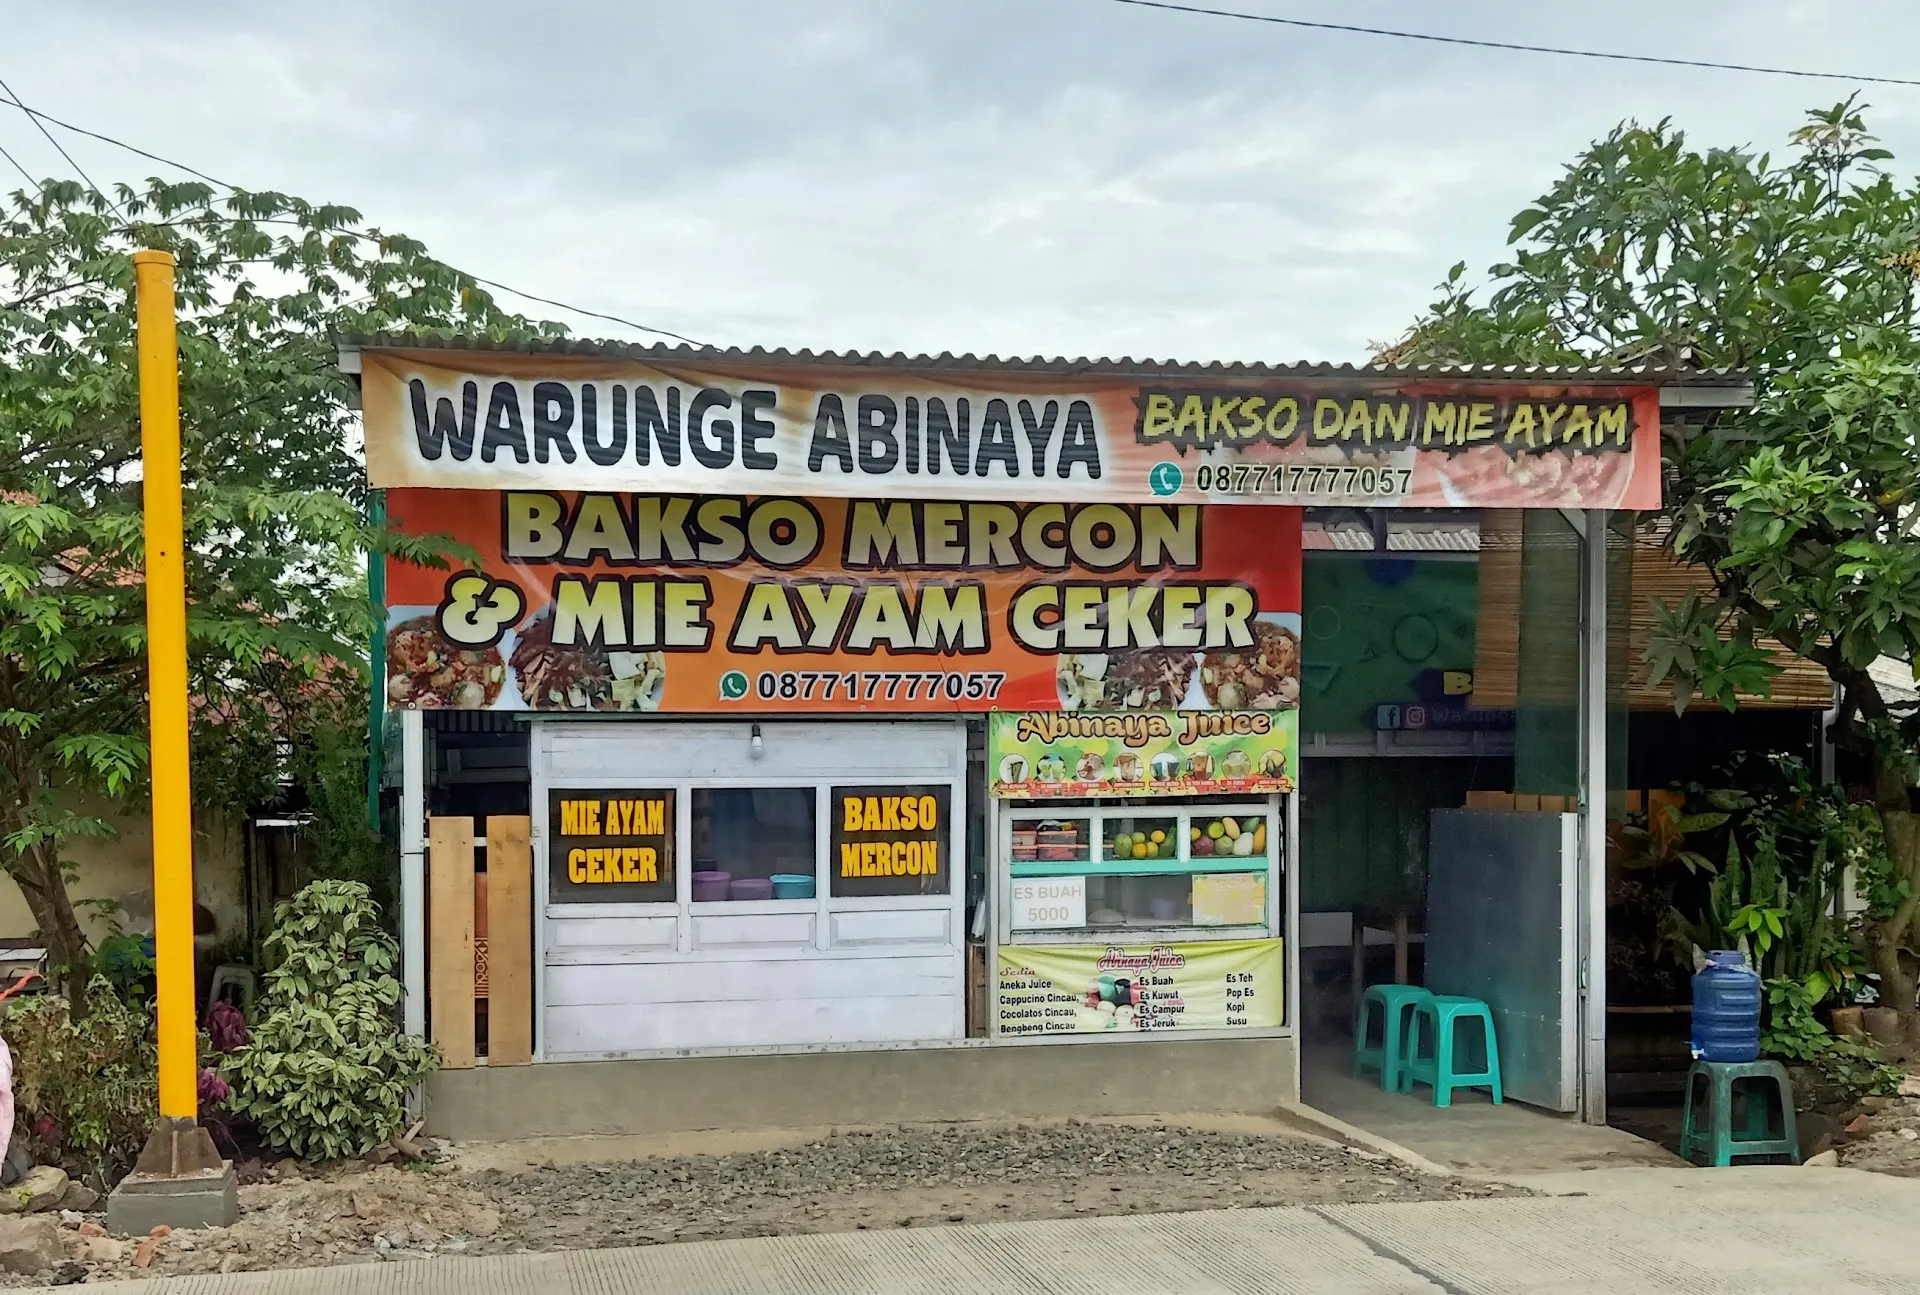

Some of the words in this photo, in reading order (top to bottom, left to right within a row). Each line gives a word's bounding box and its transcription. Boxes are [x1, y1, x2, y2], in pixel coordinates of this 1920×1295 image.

[1141, 393, 1300, 442] BAKSO
[1312, 397, 1410, 442] DAN
[1422, 400, 1496, 447] MIE
[1503, 402, 1628, 448] AYAM
[407, 378, 778, 470] WARUNGE
[807, 393, 1102, 480] ABINAYA
[1196, 465, 1412, 494] 087717777057
[504, 491, 822, 567] BAKSO
[845, 499, 1202, 569] MERCON
[439, 575, 522, 647] &
[549, 577, 710, 648] MIE
[731, 580, 988, 651] AYAM
[1010, 582, 1256, 651] CEKER
[758, 672, 1005, 699] 087717777057
[1018, 711, 1171, 748] Abinaya
[1179, 711, 1271, 746] Juice
[560, 799, 601, 836] MIE
[605, 799, 665, 836] AYAM
[843, 796, 938, 832] BAKSO
[568, 847, 659, 884] CEKER
[840, 840, 938, 878] MERCON
[1014, 887, 1034, 899] ES
[1038, 884, 1082, 899] BUAH
[1028, 906, 1069, 921] 5000
[1151, 947, 1183, 971] Juice
[1000, 980, 1026, 990] Aneka
[1028, 979, 1052, 989] Juice
[1140, 976, 1150, 986] Es
[1152, 976, 1174, 986] Buah
[1226, 974, 1236, 983] Es
[1239, 973, 1253, 983] Teh
[1000, 995, 1045, 1007] Cappucino
[1140, 991, 1150, 1000] Es
[1152, 990, 1179, 1000] Kuwut
[1226, 989, 1242, 999] Pop
[1244, 988, 1255, 997] Es
[1000, 1009, 1043, 1019] Cocolatos
[1140, 1005, 1150, 1014] Es
[1152, 1004, 1185, 1015] Campur
[1226, 1003, 1245, 1012] Kopi
[1000, 1023, 1043, 1034] Bengbeng
[1045, 1021, 1076, 1031] Cincau
[1140, 1019, 1150, 1028] Es
[1152, 1019, 1176, 1028] Jeruk
[1226, 1017, 1247, 1026] Susu
